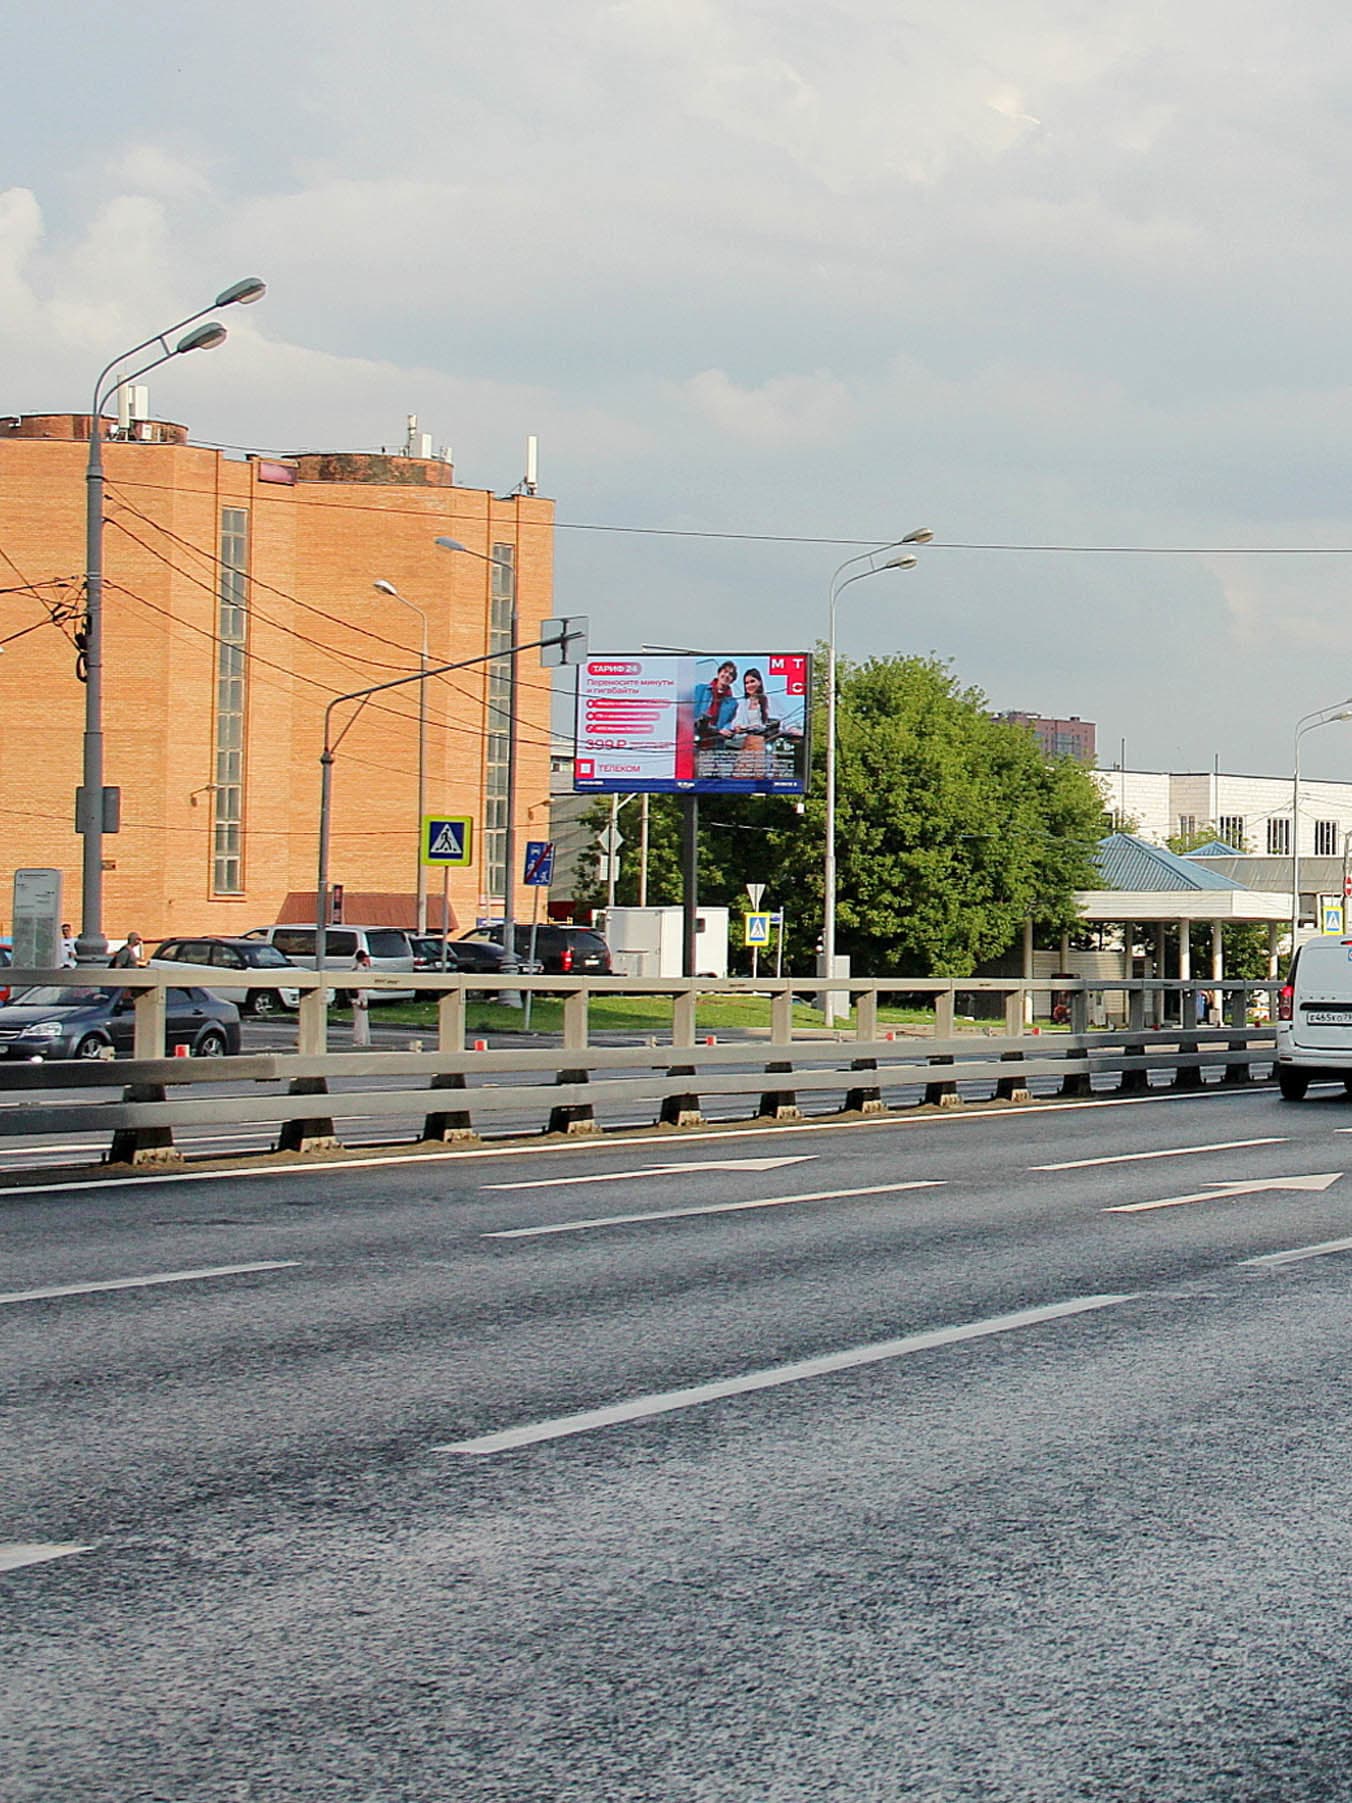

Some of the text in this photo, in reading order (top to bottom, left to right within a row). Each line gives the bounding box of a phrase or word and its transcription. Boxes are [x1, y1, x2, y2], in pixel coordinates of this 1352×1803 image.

[592, 665, 624, 673] ТАРИФ
[587, 679, 639, 687] Переносите
[599, 764, 641, 773] ТЕЛЕКОМ
